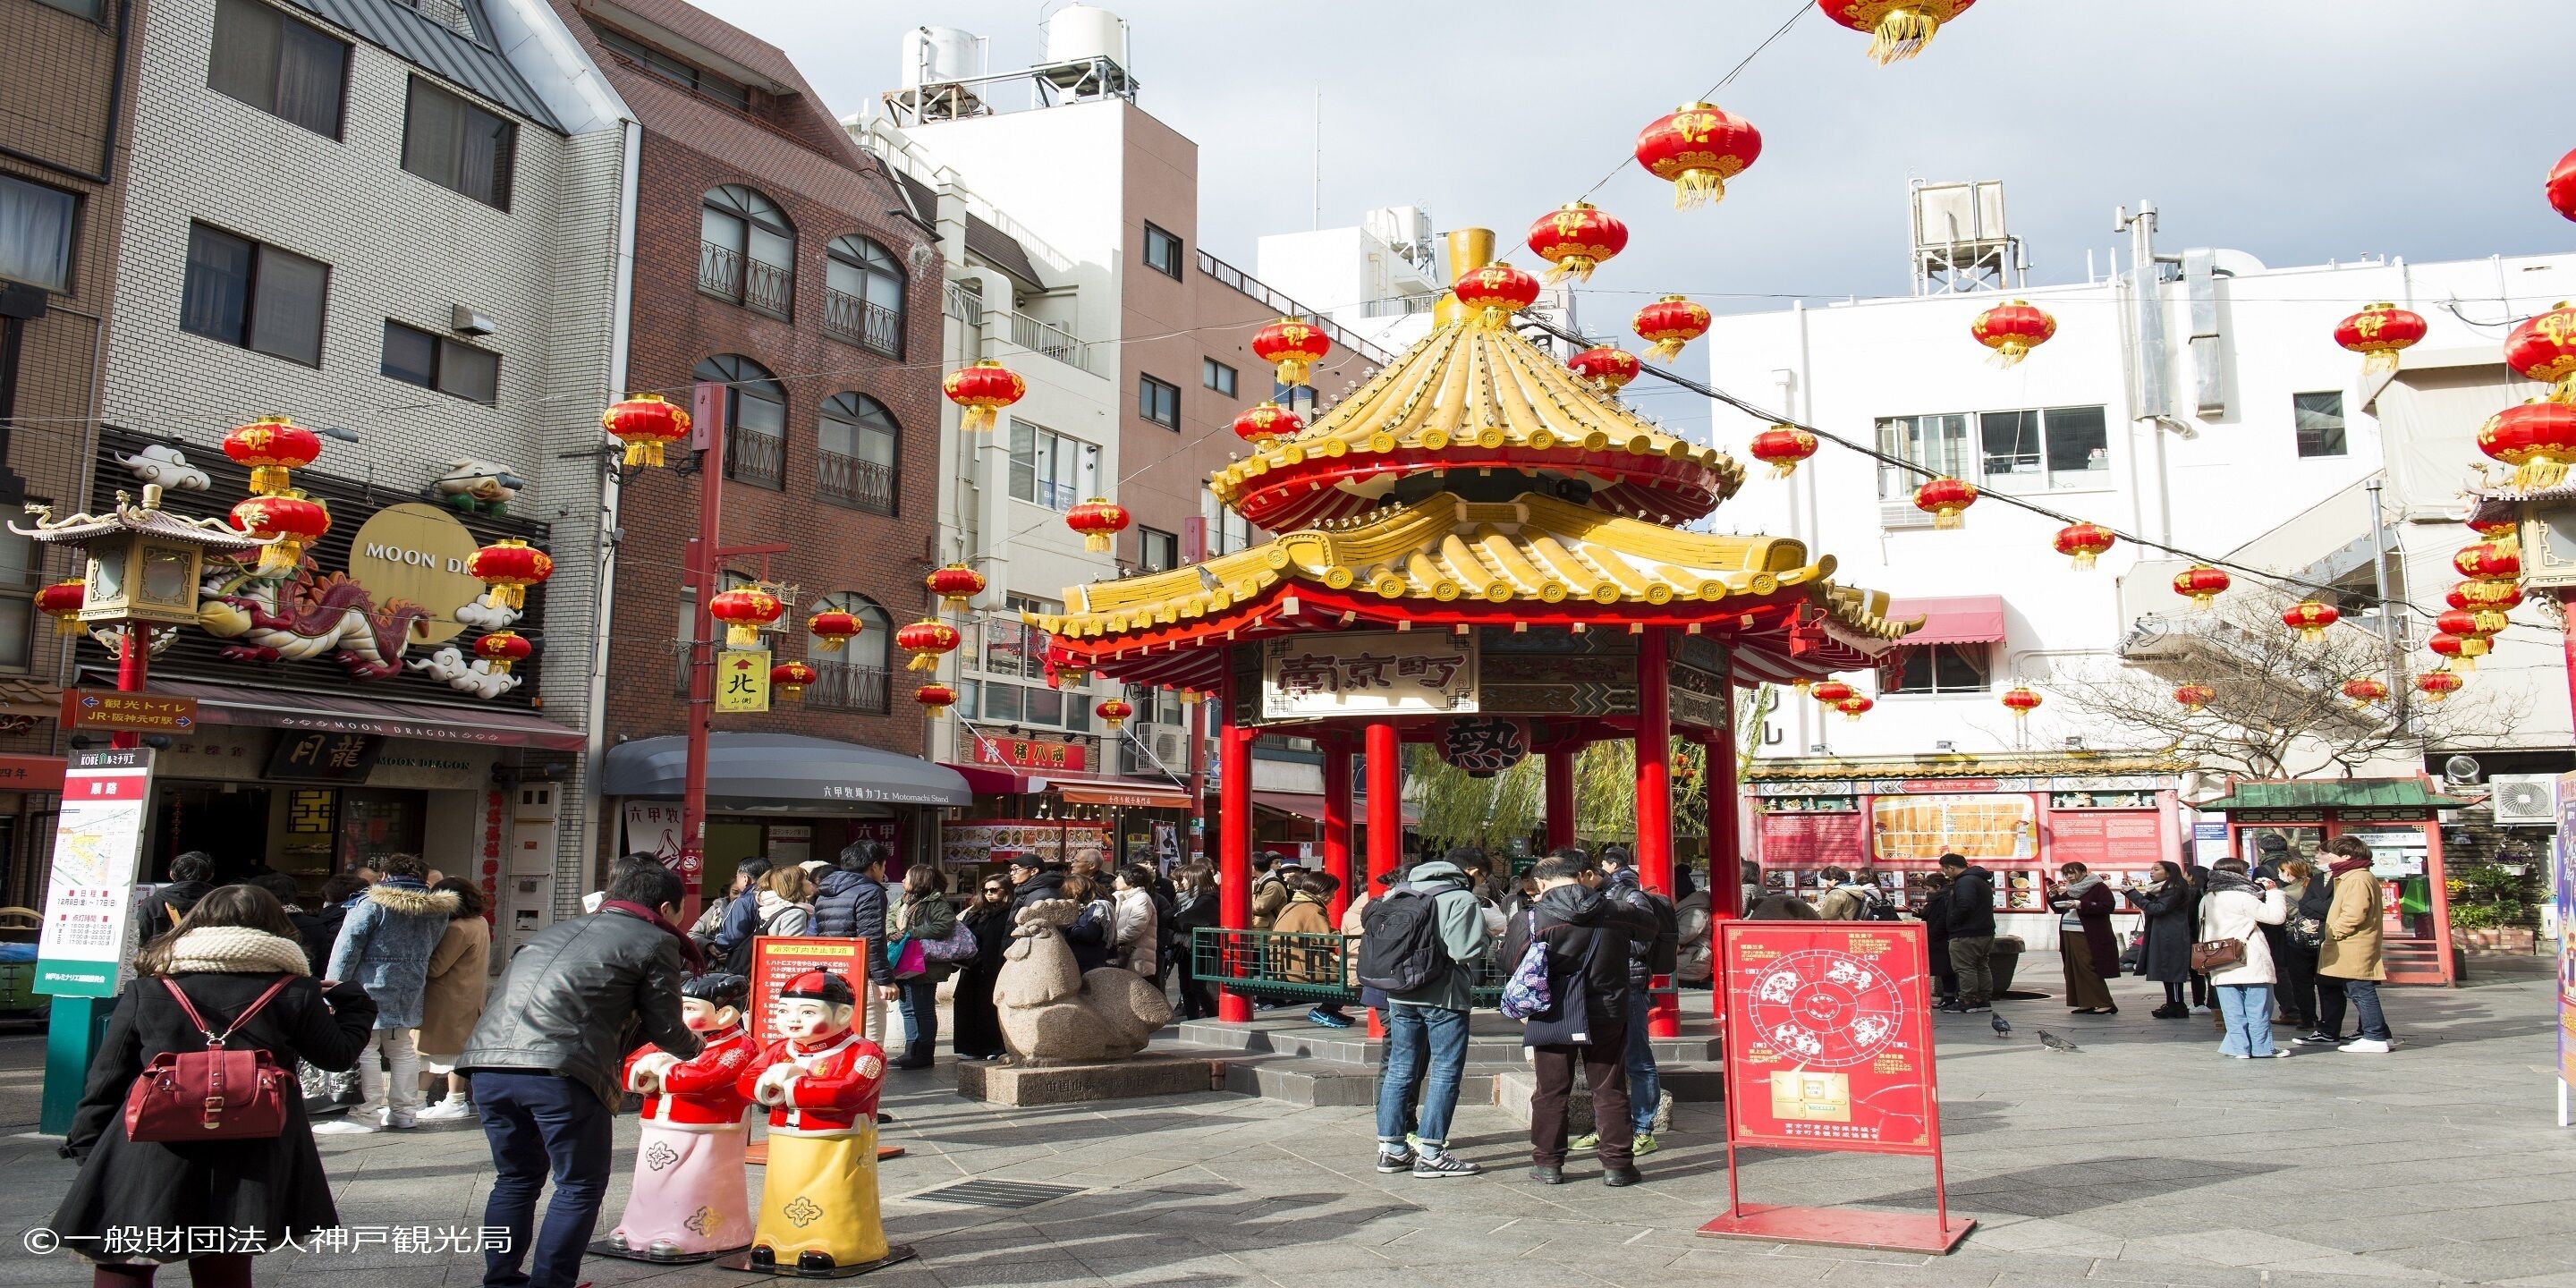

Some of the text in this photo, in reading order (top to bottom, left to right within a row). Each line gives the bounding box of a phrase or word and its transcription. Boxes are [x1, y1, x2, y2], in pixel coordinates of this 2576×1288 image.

[365, 542, 436, 569] MOON
[1275, 651, 1467, 695] 南京町
[727, 673, 757, 694] 北
[104, 698, 186, 713] 観光トイレ
[335, 721, 457, 739] MOON DRAGON
[80, 756, 99, 766] KOBE
[892, 792, 930, 802] Motomachi
[931, 794, 949, 803] Stand
